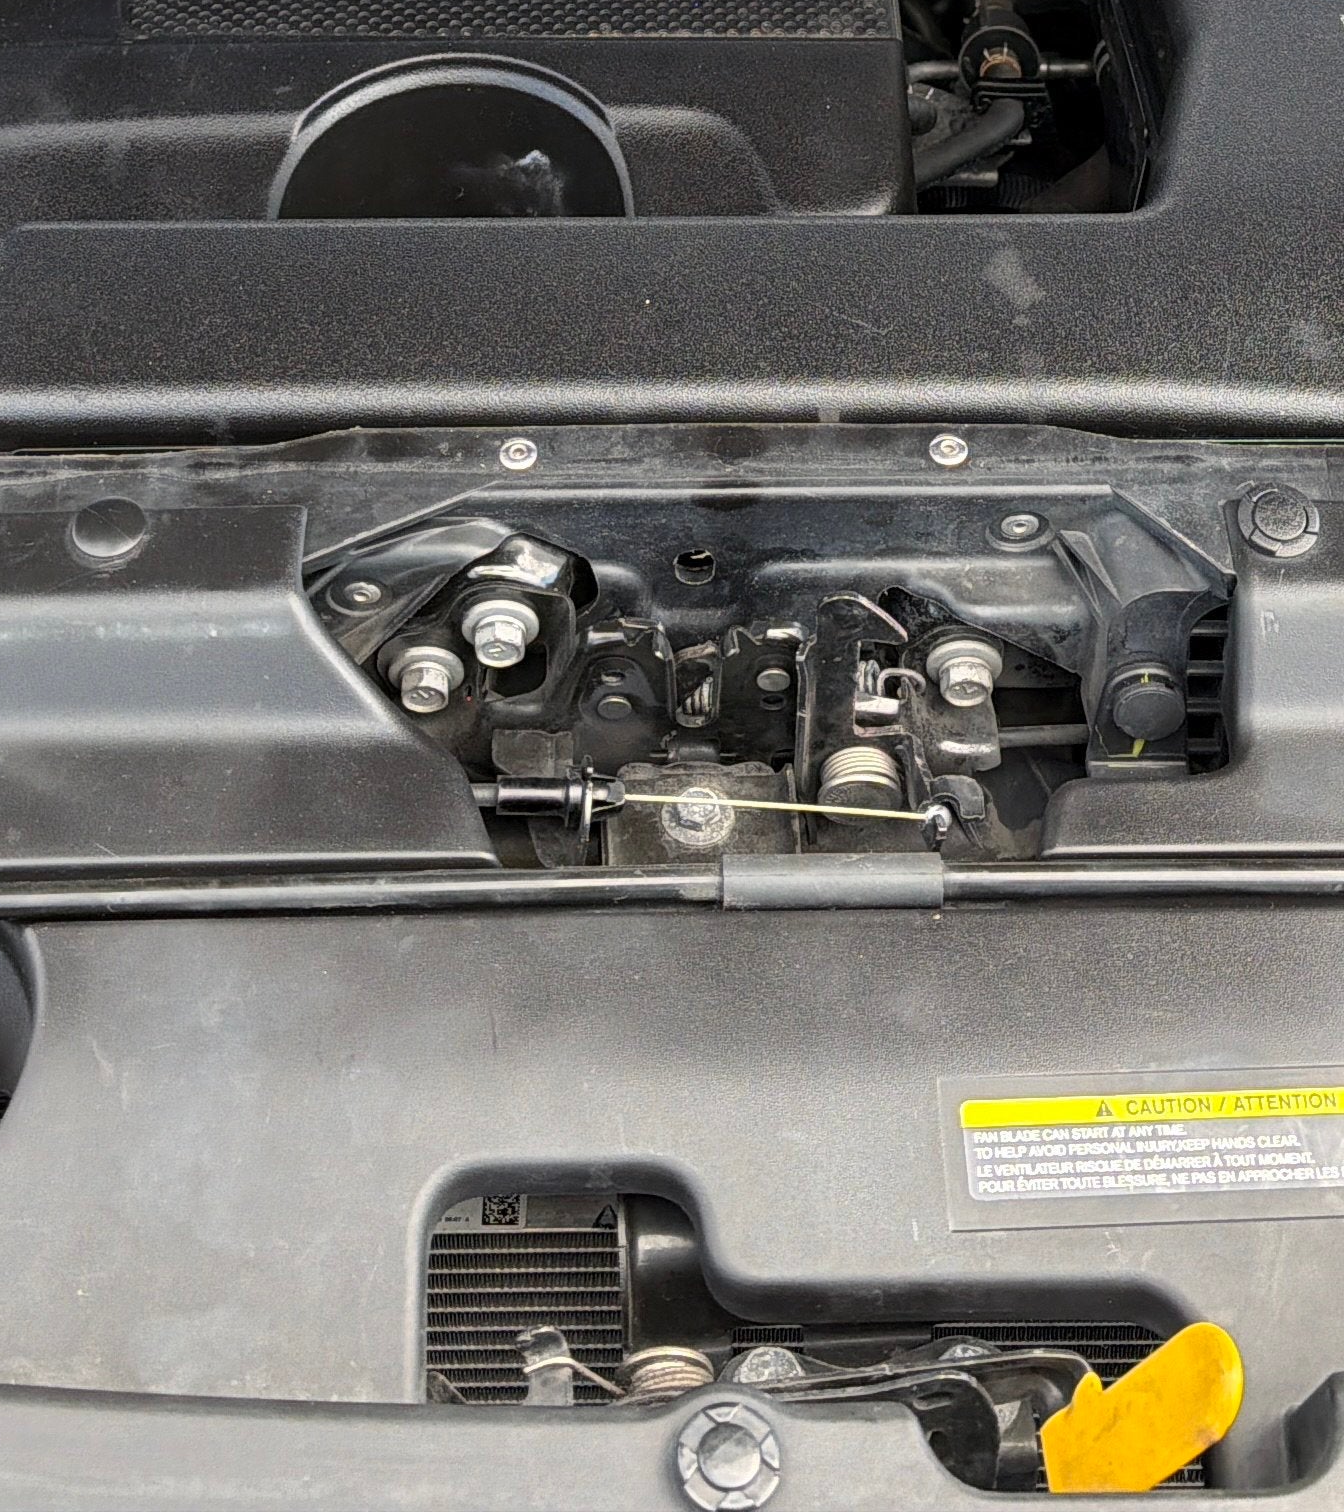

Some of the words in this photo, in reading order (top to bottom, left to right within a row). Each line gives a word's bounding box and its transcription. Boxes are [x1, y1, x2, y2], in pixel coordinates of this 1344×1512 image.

[1126, 1097, 1211, 1116] CAUTION
[1234, 1093, 1337, 1112] ATTENTION
[974, 1131, 998, 1143] FAN
[1000, 1129, 1041, 1143] BLADE
[1042, 1128, 1069, 1141] CAN
[1072, 1127, 1110, 1140] START
[1112, 1126, 1126, 1139] AT
[1129, 1125, 1154, 1137] ANY
[974, 1146, 993, 1160] TO
[995, 1145, 1028, 1159] HELP
[1029, 1144, 1066, 1157] AVOID
[1068, 1141, 1135, 1156] PERSONAL
[1212, 1136, 1255, 1150] HANDS
[977, 1164, 993, 1178] LE
[995, 1162, 1075, 1177] VENTILATEUR
[1076, 1159, 1124, 1174] RISQUE
[1125, 1159, 1142, 1172] DE
[1143, 1155, 1211, 1171] DÉMARRER
[1223, 1154, 1257, 1168] TOUT
[978, 1180, 1016, 1194] POUR
[1017, 1176, 1060, 1192] ÉVITER
[1061, 1176, 1101, 1191] TOUTE
[1172, 1172, 1189, 1186] NE
[1191, 1171, 1216, 1185] PAS
[1218, 1170, 1236, 1184] EN
[1238, 1168, 1315, 1182] APPROCHER
[1316, 1166, 1341, 1180] LES
